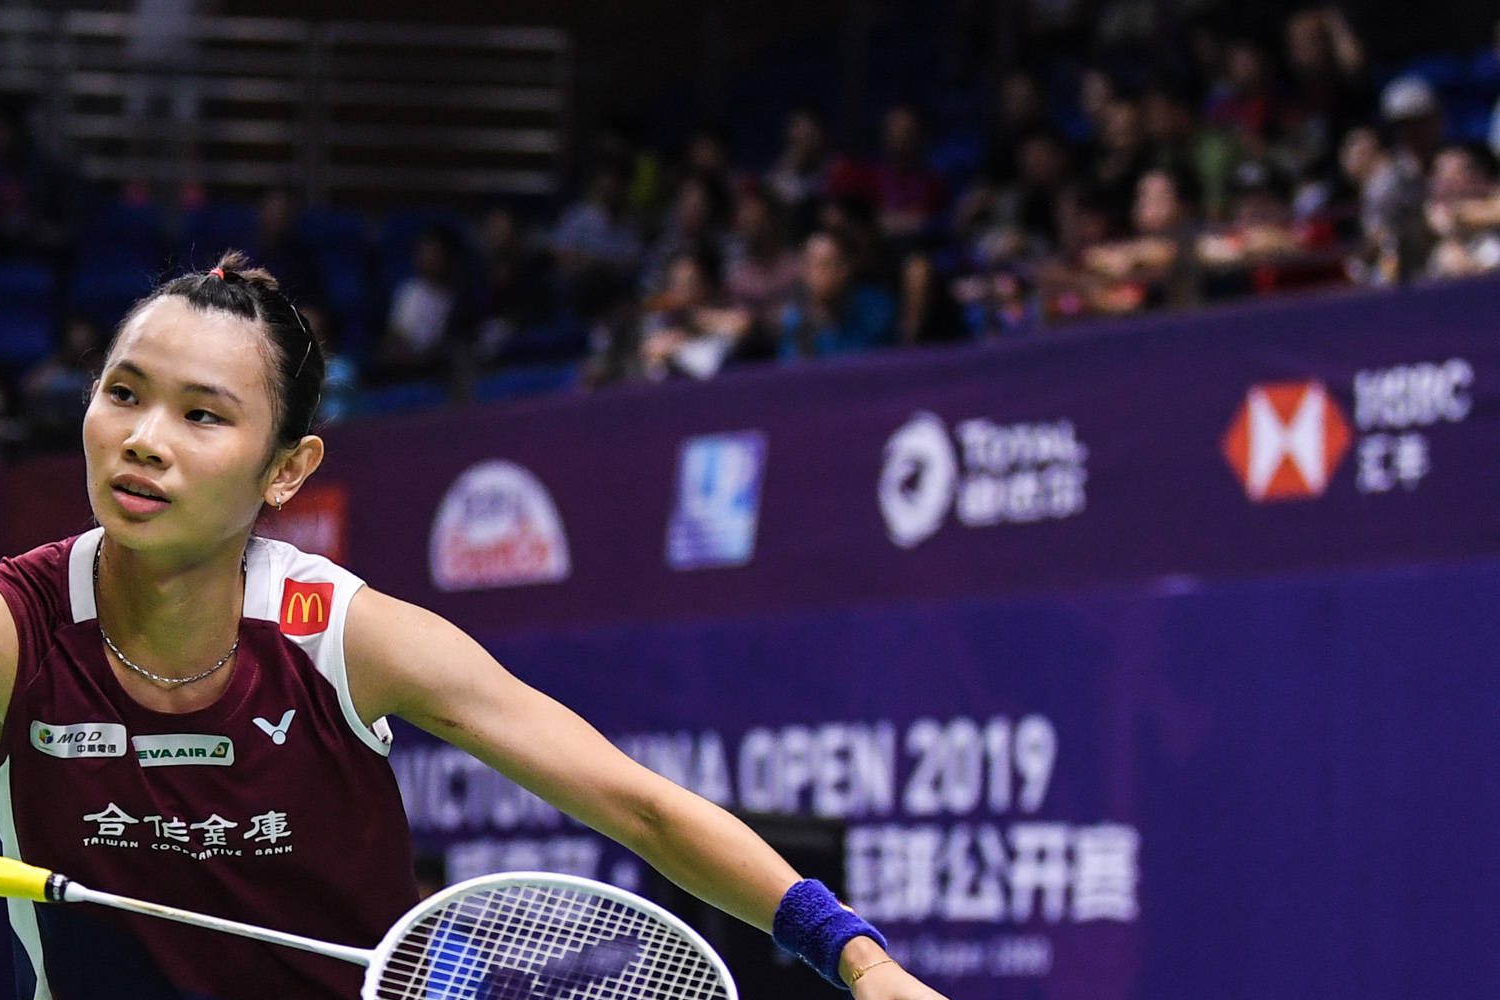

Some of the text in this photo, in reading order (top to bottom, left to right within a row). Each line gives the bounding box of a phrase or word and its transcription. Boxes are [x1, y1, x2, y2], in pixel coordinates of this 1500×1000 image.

[57, 731, 102, 743] MOD
[738, 720, 896, 816] OPEN
[903, 713, 1057, 816] 2019
[83, 837, 139, 848] TAIWAN
[255, 845, 293, 856] BANK
